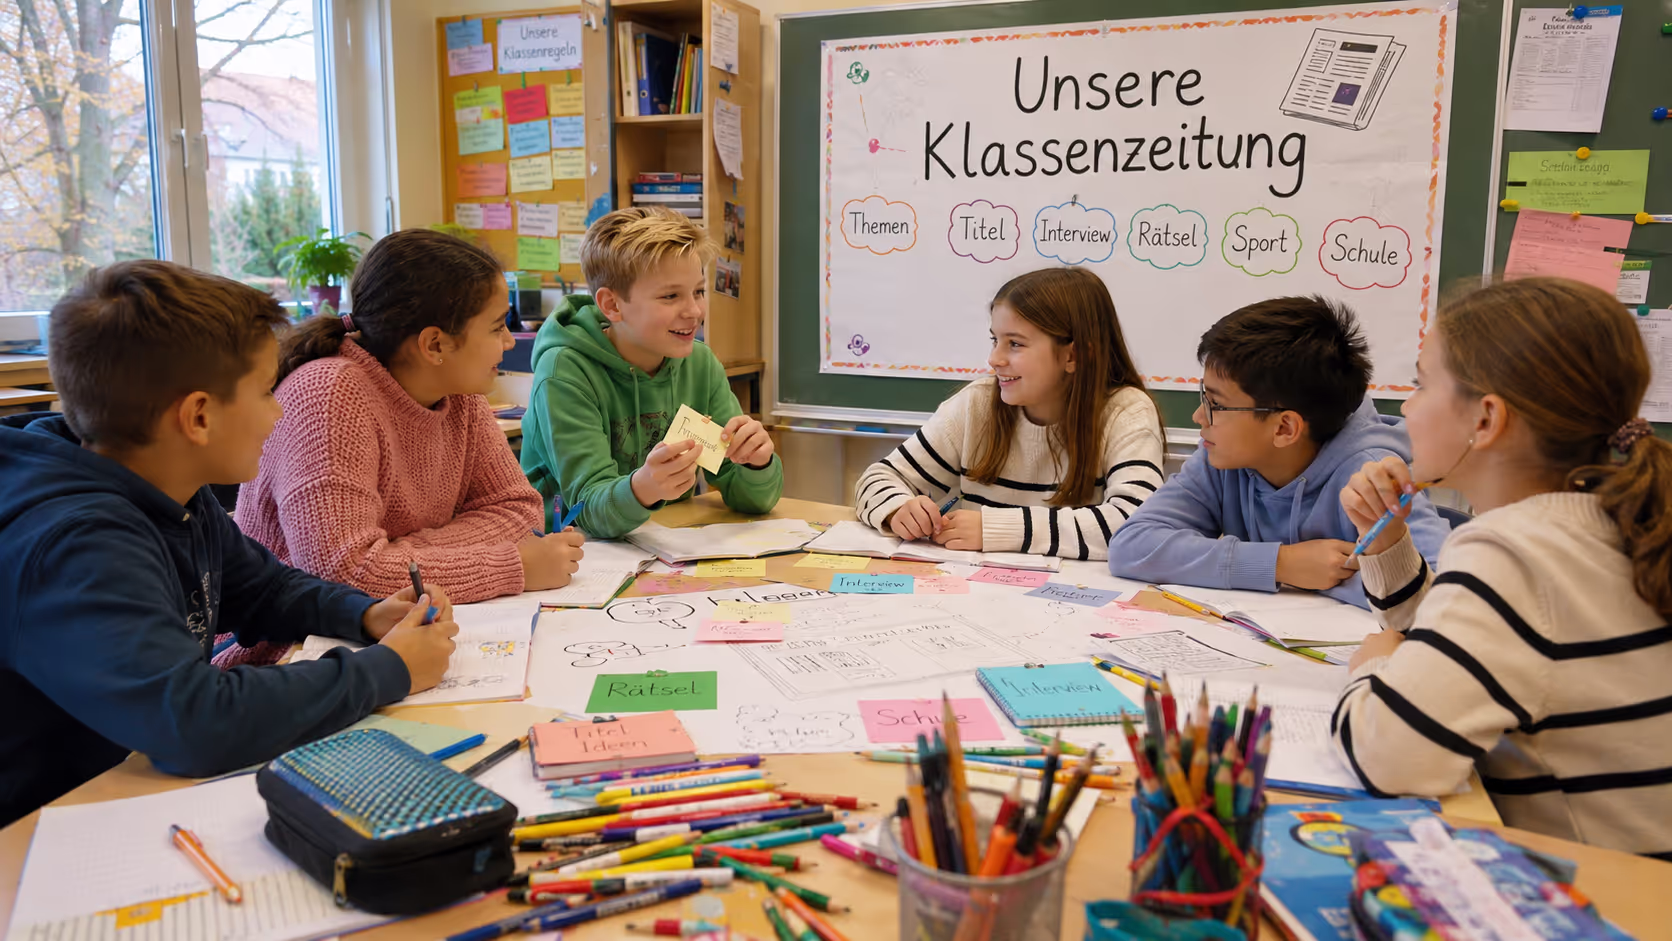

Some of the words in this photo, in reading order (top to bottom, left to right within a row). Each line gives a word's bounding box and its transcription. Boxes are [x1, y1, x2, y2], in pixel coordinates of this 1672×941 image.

[520, 25, 558, 40] Unsere
[504, 41, 576, 62] Klassenregeln
[1014, 56, 1205, 113] Unsere
[924, 116, 1307, 198] Klassenzeitung
[849, 211, 909, 235] Themen
[960, 216, 1006, 241] Titel
[1040, 219, 1112, 243] Interview
[1138, 221, 1198, 248] Rätsel
[1231, 225, 1288, 261] Sport
[1330, 234, 1399, 266] Schule
[840, 577, 905, 588] Interview
[607, 680, 703, 698] Rätsel
[877, 709, 971, 726] Schue
[574, 724, 631, 739] Titel
[582, 739, 649, 753] Ideen
